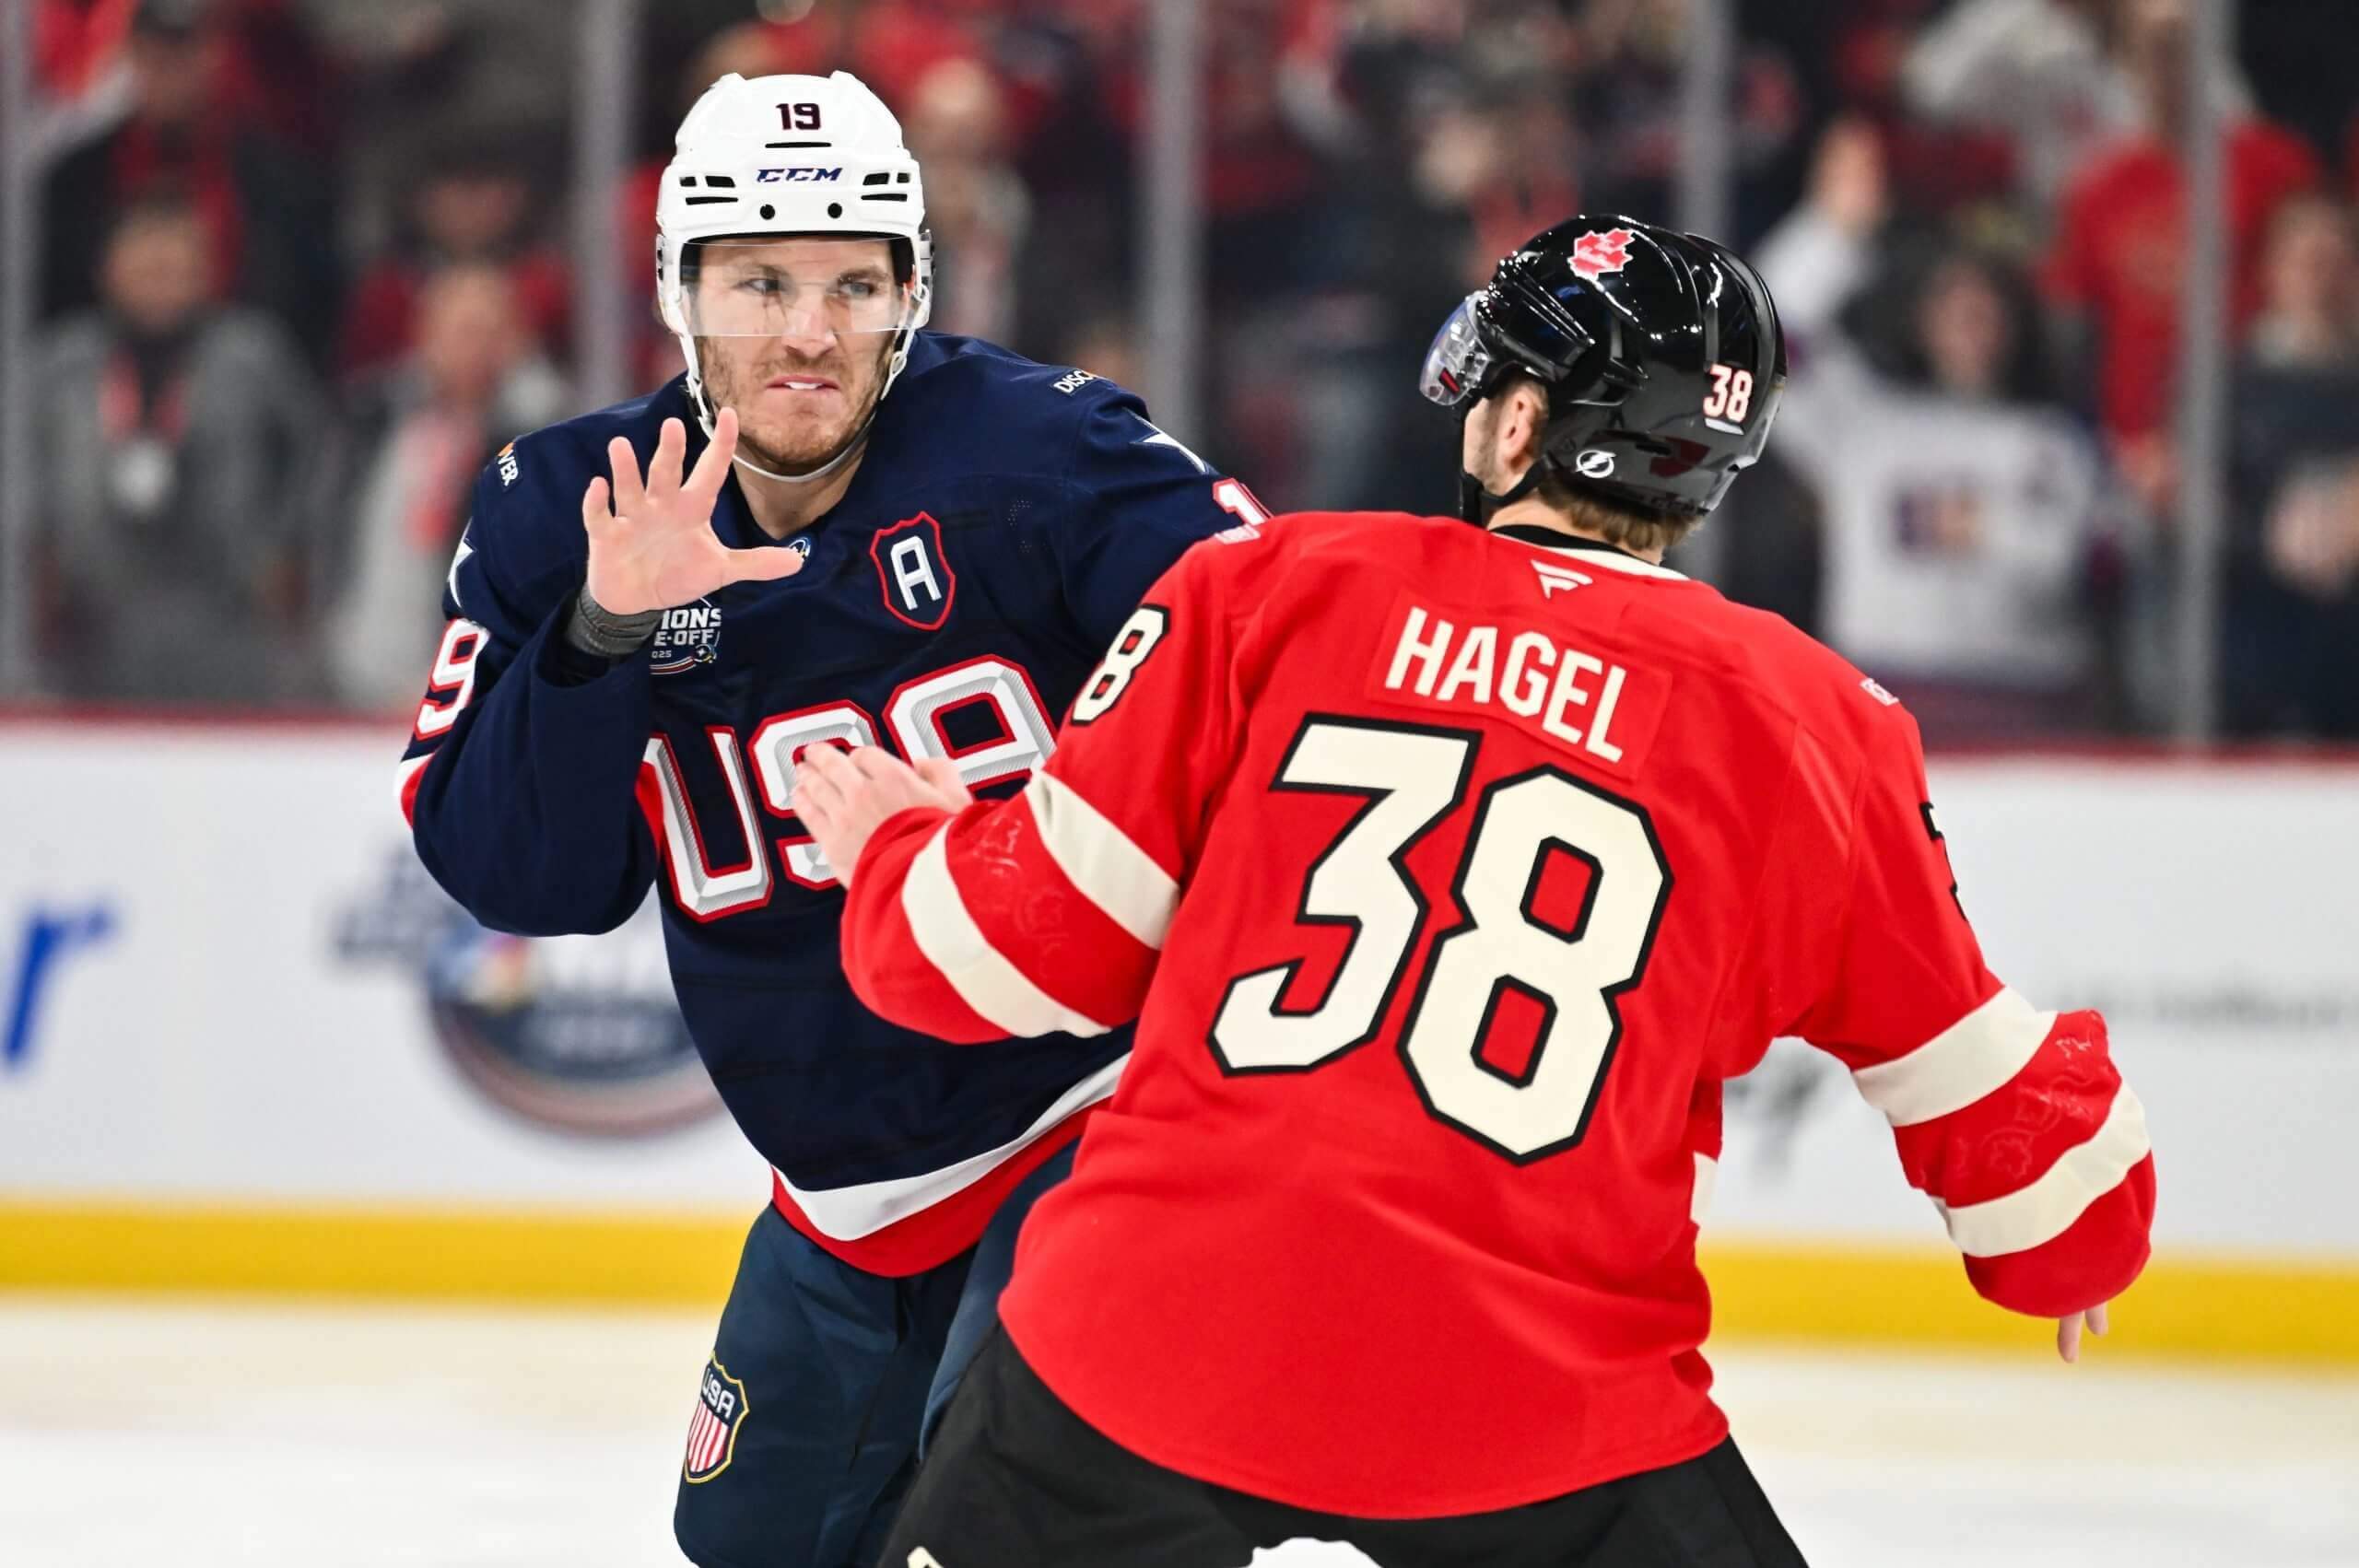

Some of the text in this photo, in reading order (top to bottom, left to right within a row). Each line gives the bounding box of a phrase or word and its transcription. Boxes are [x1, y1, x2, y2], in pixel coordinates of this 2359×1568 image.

[775, 102, 822, 131] 19
[756, 167, 843, 183] CCM
[1702, 363, 1755, 424] 38
[889, 531, 942, 611] A
[653, 628, 715, 647] E-OFF
[661, 608, 722, 630] IONS
[651, 649, 673, 660] 025
[1384, 605, 1627, 764] HAGEL
[1205, 710, 1675, 1168] 38
[701, 1367, 736, 1420] USA
